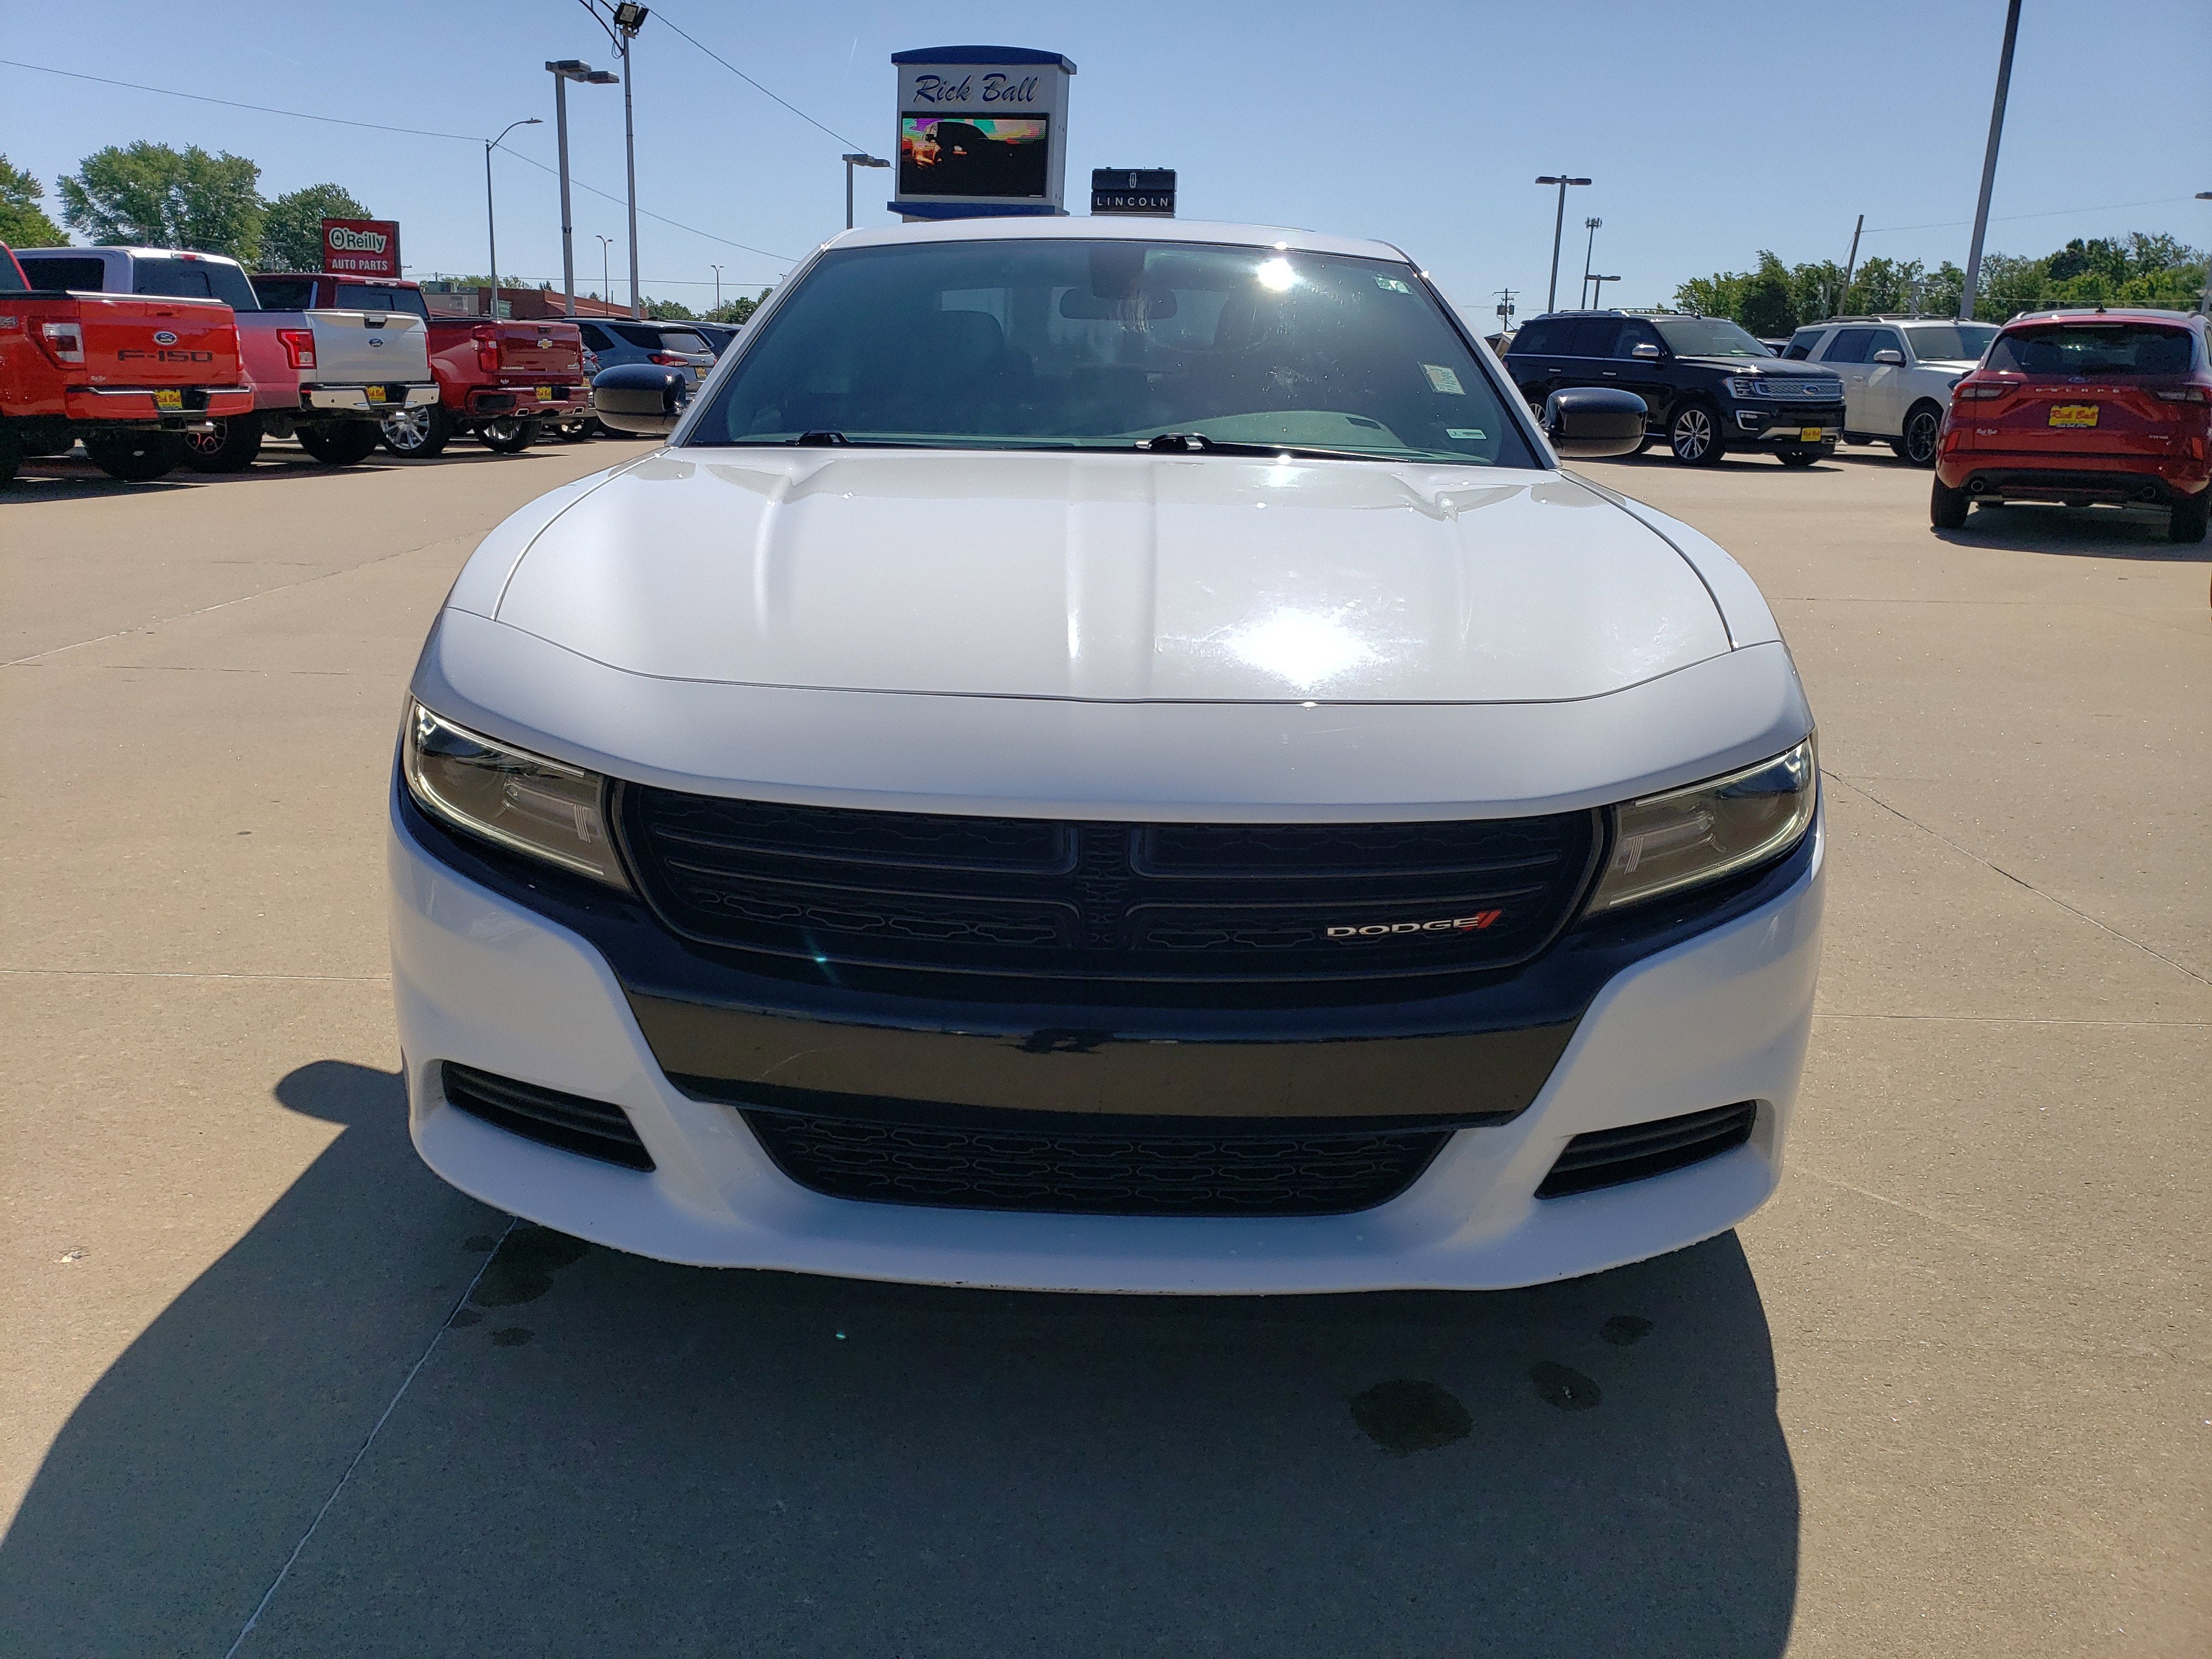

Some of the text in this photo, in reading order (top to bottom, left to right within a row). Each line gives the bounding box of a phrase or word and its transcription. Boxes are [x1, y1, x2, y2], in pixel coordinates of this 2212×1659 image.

[913, 73, 1039, 103] Rick Ball
[1097, 197, 1169, 207] LINCOLN
[330, 228, 386, 252] O'Reilly
[332, 258, 388, 270] AUTO PARTS
[117, 349, 213, 362] F-150
[1327, 917, 1480, 937] DODGE
